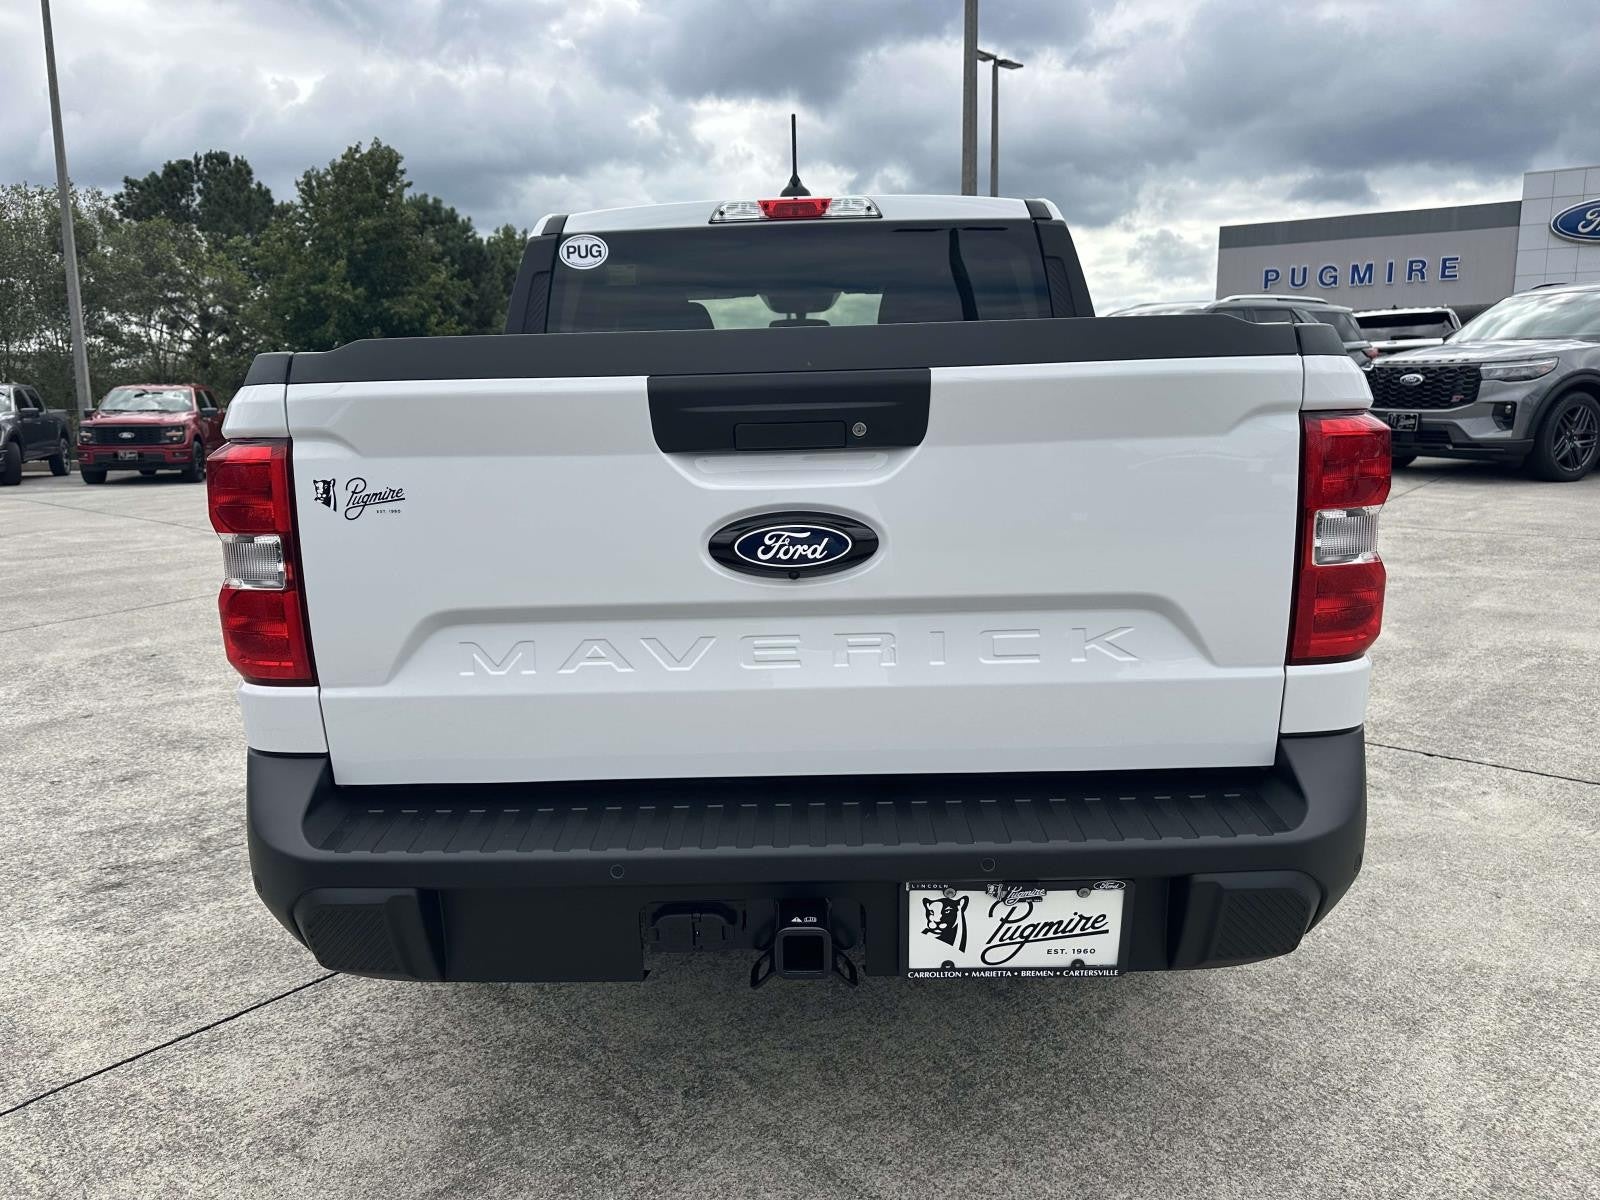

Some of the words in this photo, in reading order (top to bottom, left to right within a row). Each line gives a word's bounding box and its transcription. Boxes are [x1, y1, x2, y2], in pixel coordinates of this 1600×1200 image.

[566, 243, 602, 259] PUG
[1263, 256, 1461, 290] PUGMIRE
[344, 477, 406, 521] Pugmire
[757, 531, 829, 560] Ford
[459, 626, 1140, 677] MAVERICK
[980, 899, 1110, 966] Pugmire
[907, 971, 962, 979] CARROLLTON
[971, 970, 1012, 978] MARIETTA
[1021, 969, 1054, 978] BREMEN
[1062, 969, 1119, 977] CARTERSVILLE
